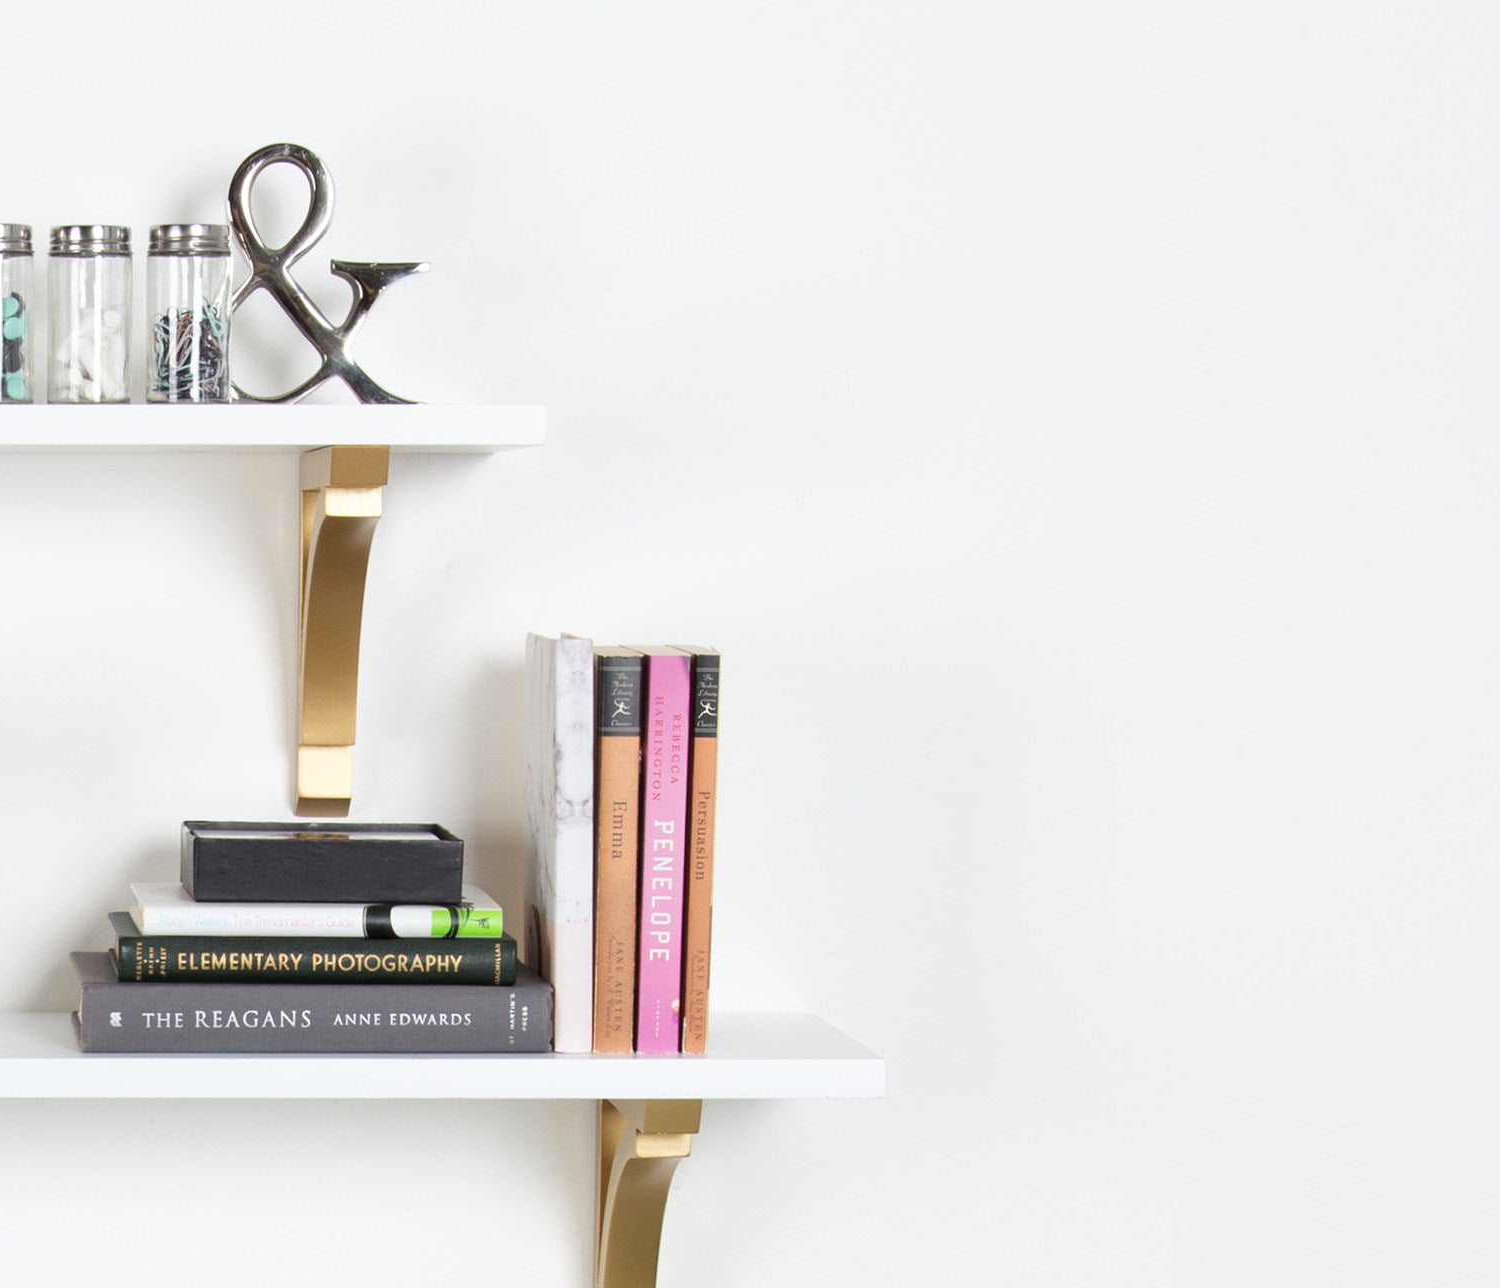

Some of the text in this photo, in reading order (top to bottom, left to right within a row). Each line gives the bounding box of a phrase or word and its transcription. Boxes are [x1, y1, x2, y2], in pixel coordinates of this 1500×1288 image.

[652, 696, 665, 801] HARRINGTON
[671, 714, 682, 785] REBECCA
[612, 800, 627, 860] Emma
[695, 790, 711, 881] Persuasion
[234, 915, 252, 927] The
[649, 820, 674, 961] PENELOPE
[178, 952, 463, 972] ELEMENTARY PHOTOGRAPHY
[614, 940, 624, 1032] JANE AUSTEN
[695, 949, 706, 1040] JANE AUSTEN
[142, 1010, 312, 1029] THE REAGANS
[333, 1013, 472, 1026] ANNE EDWARDS
